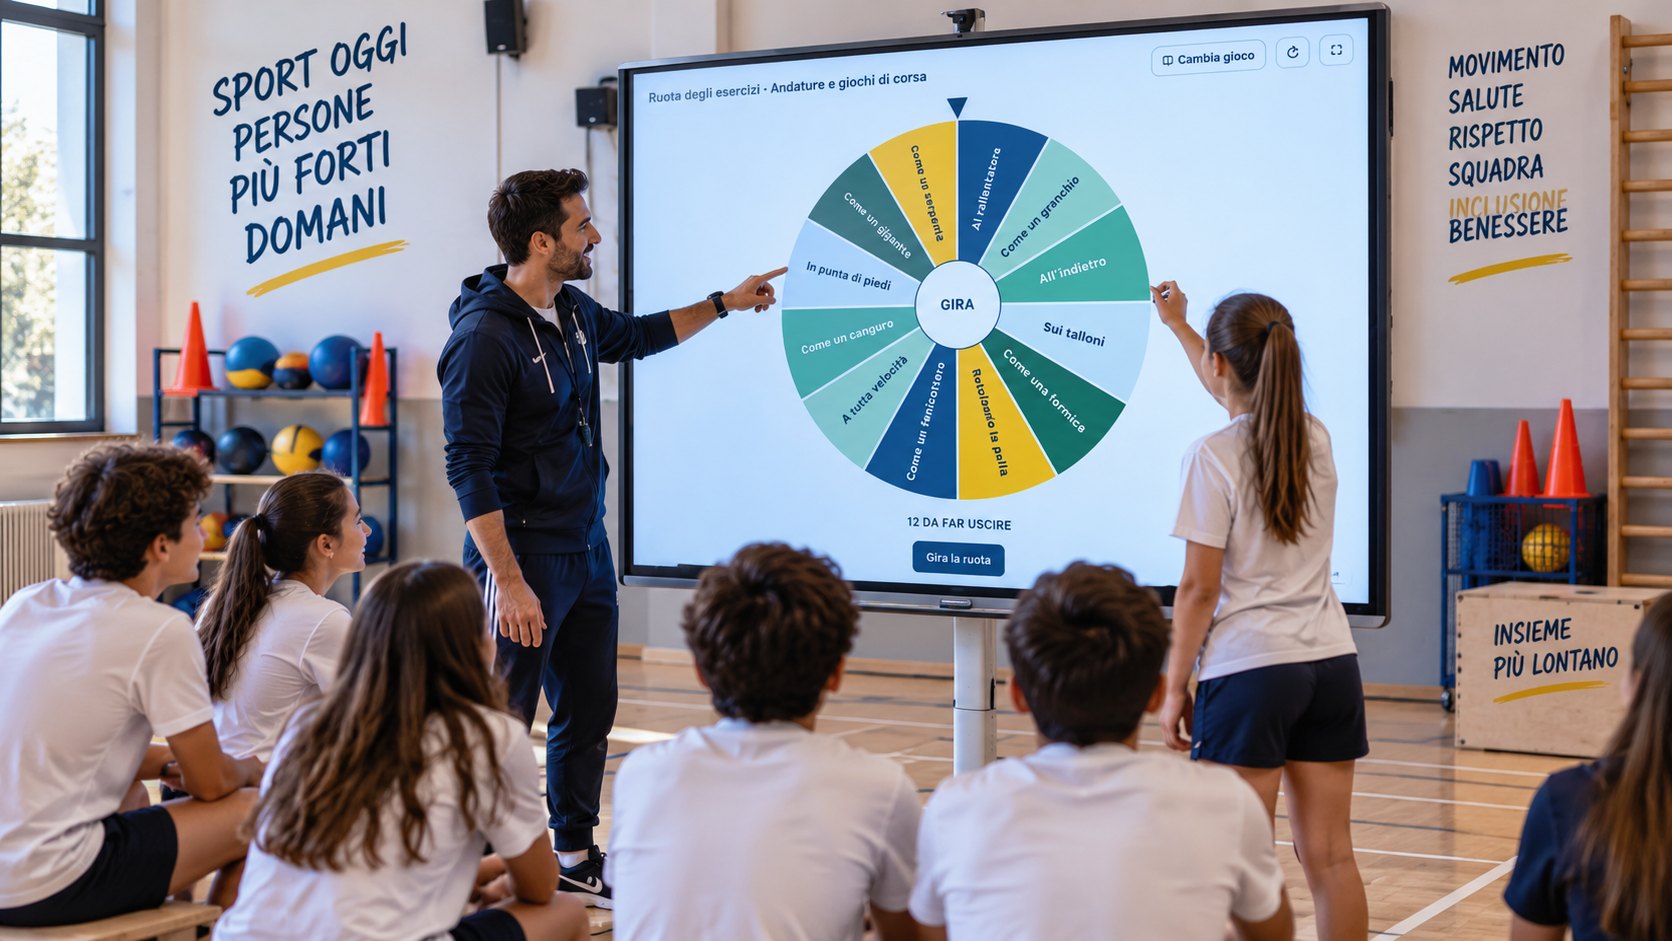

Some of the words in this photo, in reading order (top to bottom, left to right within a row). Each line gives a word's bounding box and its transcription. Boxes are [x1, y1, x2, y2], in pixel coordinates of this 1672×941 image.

[213, 48, 317, 116] SPORT
[331, 22, 406, 76] OGGI
[1178, 52, 1220, 64] Cambia
[1223, 51, 1255, 64] gioco
[1449, 43, 1565, 79] MOVIMENTO
[649, 92, 681, 103] Ruota
[685, 87, 712, 102] degli
[716, 85, 760, 97] esercizi
[771, 78, 825, 94] Andature
[828, 79, 835, 89] e
[839, 75, 874, 90] giochi
[878, 73, 889, 84] di
[893, 71, 927, 84] corsa
[1449, 83, 1524, 114] SALUTE
[233, 83, 373, 161] PERSONE
[1449, 118, 1543, 150] RISPETTO
[230, 158, 279, 214] PIÙ
[295, 130, 389, 194] FORTI
[1449, 154, 1543, 187] SQUADRA
[245, 186, 385, 264] DOMANI
[844, 192, 866, 215] Come
[867, 214, 877, 226] un
[972, 218, 982, 231] Al
[1001, 231, 1028, 258] Come
[1028, 217, 1041, 230] un
[1041, 176, 1079, 218] granchio
[1449, 208, 1568, 243] BENESSERE
[807, 262, 816, 271] In
[818, 266, 848, 280] punta
[851, 273, 862, 283] di
[863, 277, 891, 290] piedi
[1040, 258, 1106, 284] All'indietro
[941, 299, 974, 310] GIRA
[801, 340, 831, 354] Come
[834, 335, 847, 344] un
[850, 320, 893, 339] canguro
[1044, 322, 1063, 335] Sui
[1066, 328, 1105, 347] talloni
[842, 414, 851, 424] A
[850, 393, 872, 415] tutta
[872, 356, 908, 392] velocità
[1003, 349, 1031, 377] Come
[1031, 376, 1048, 395] una
[1049, 394, 1085, 433] formica
[907, 448, 922, 480] Come
[918, 430, 927, 444] un
[908, 517, 919, 526] 12
[923, 517, 938, 528] DA
[942, 518, 964, 528] FAR
[968, 519, 1011, 530] USCIRE
[926, 552, 948, 562] Gira
[951, 553, 959, 563] la
[963, 556, 991, 565] ruota
[1494, 618, 1571, 646] INSIEME
[1494, 650, 1524, 679] PIÙ
[1533, 647, 1618, 675] LONTANO
